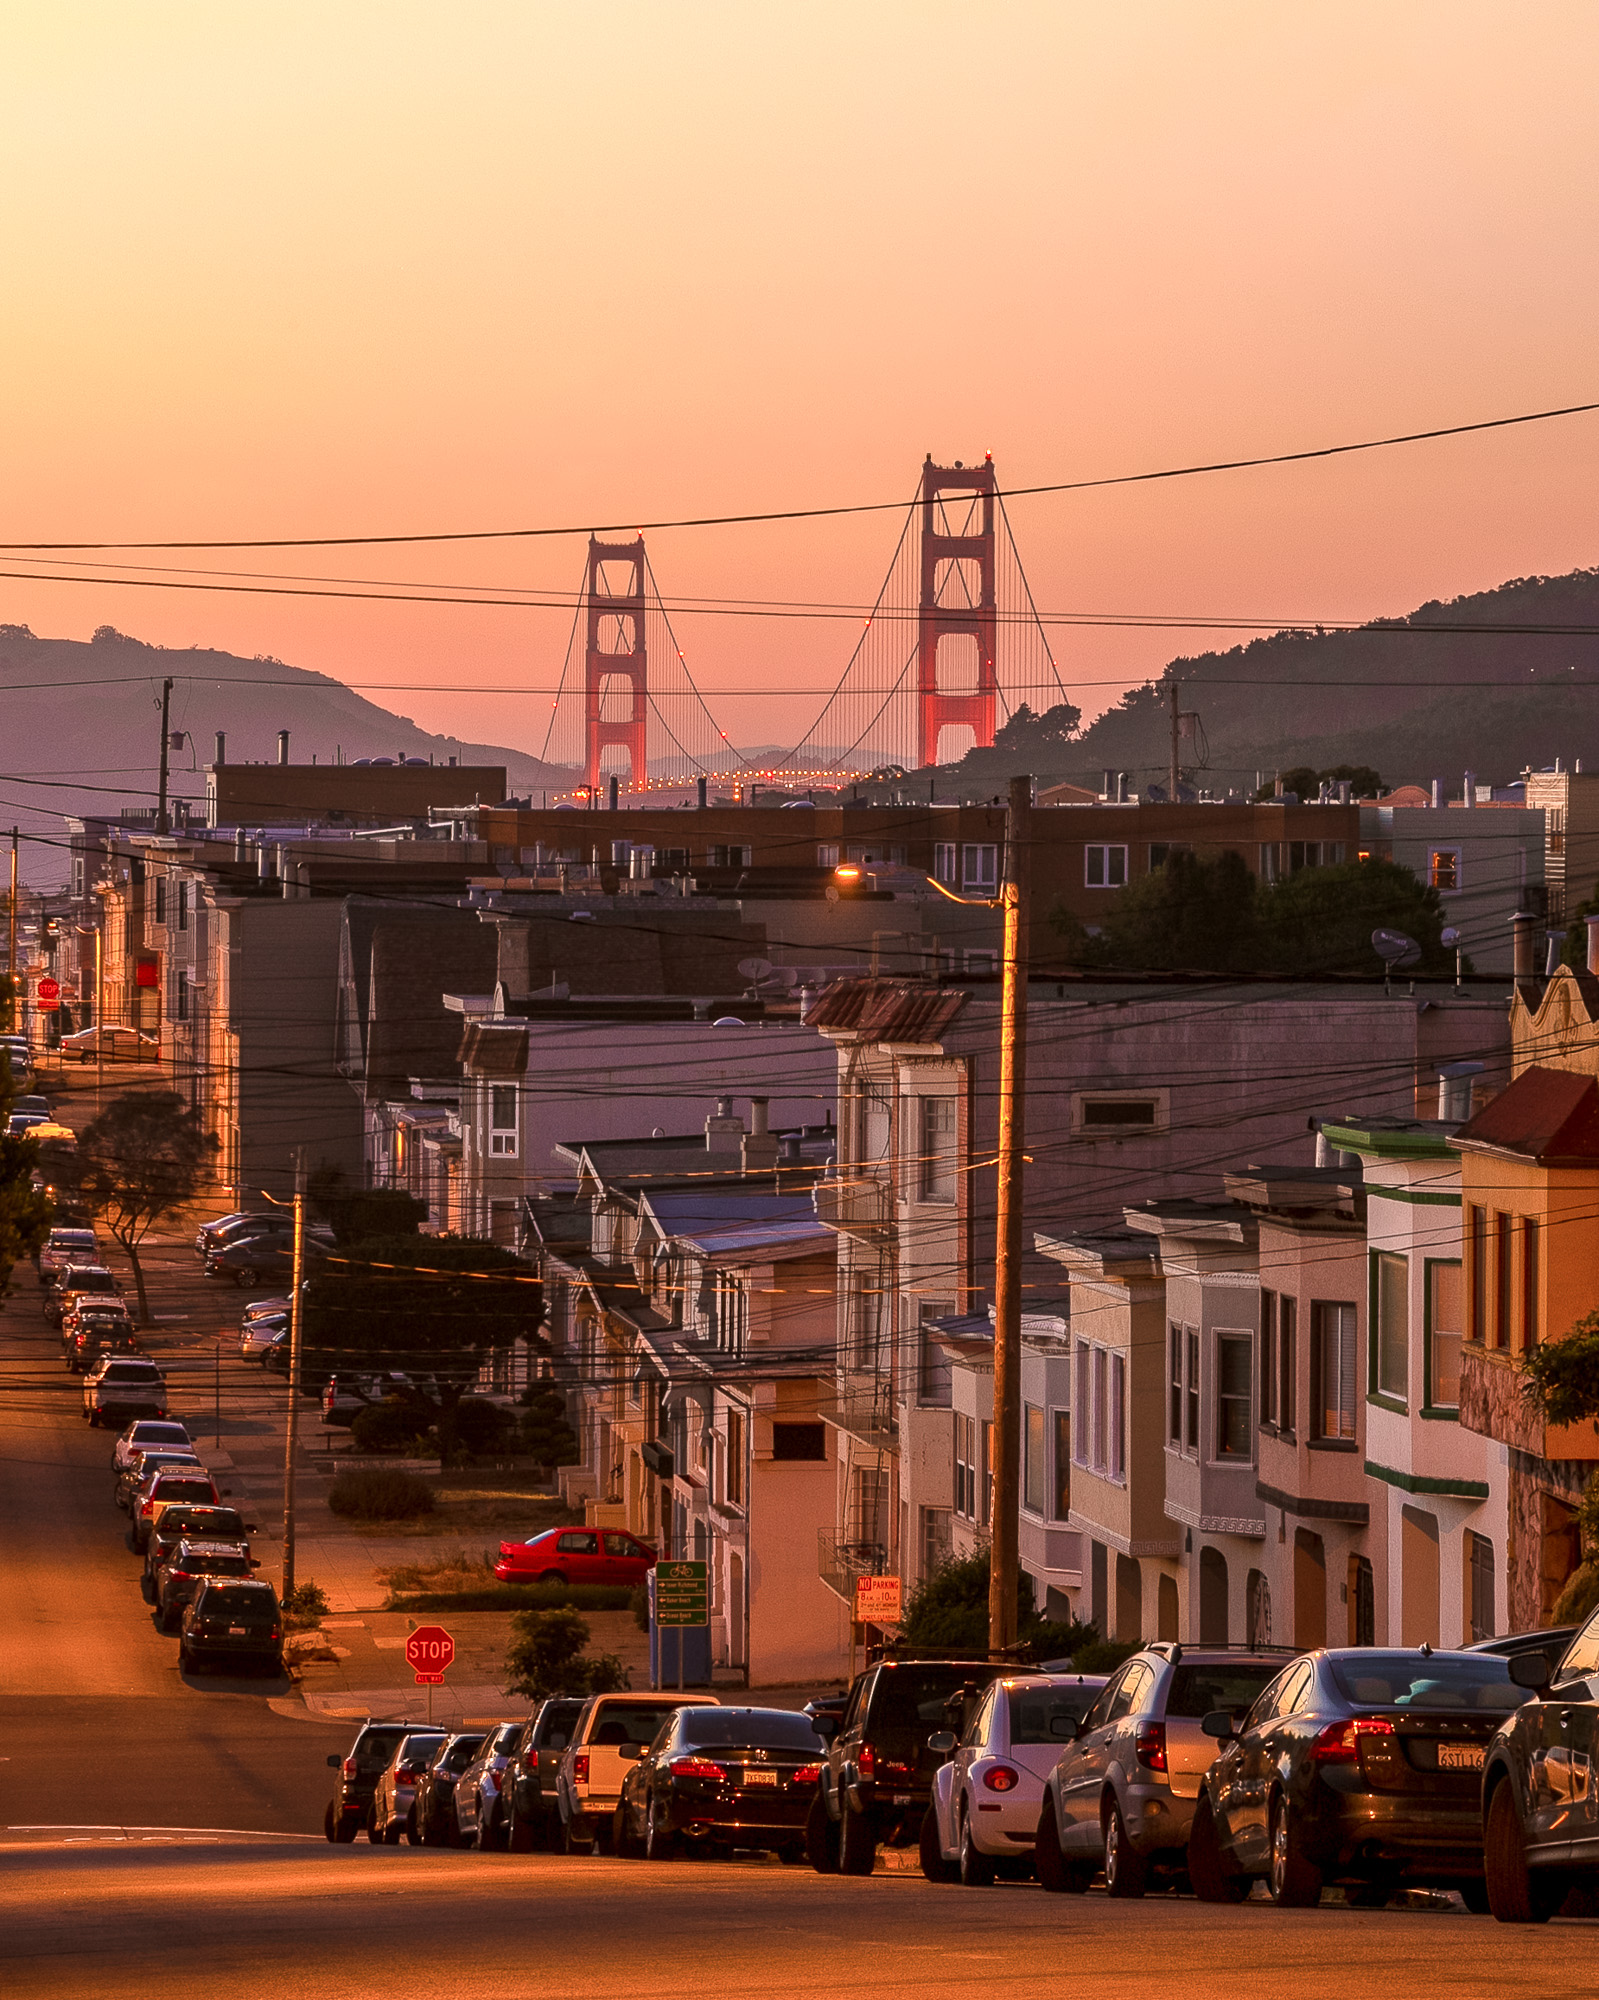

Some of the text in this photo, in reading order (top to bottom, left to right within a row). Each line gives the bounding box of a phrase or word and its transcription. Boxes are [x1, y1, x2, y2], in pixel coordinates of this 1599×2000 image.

[39, 984, 58, 994] STOP
[859, 1578, 899, 1590] NO PARKING
[408, 1640, 452, 1659] STOP
[1440, 1752, 1486, 1767] 6STL16
